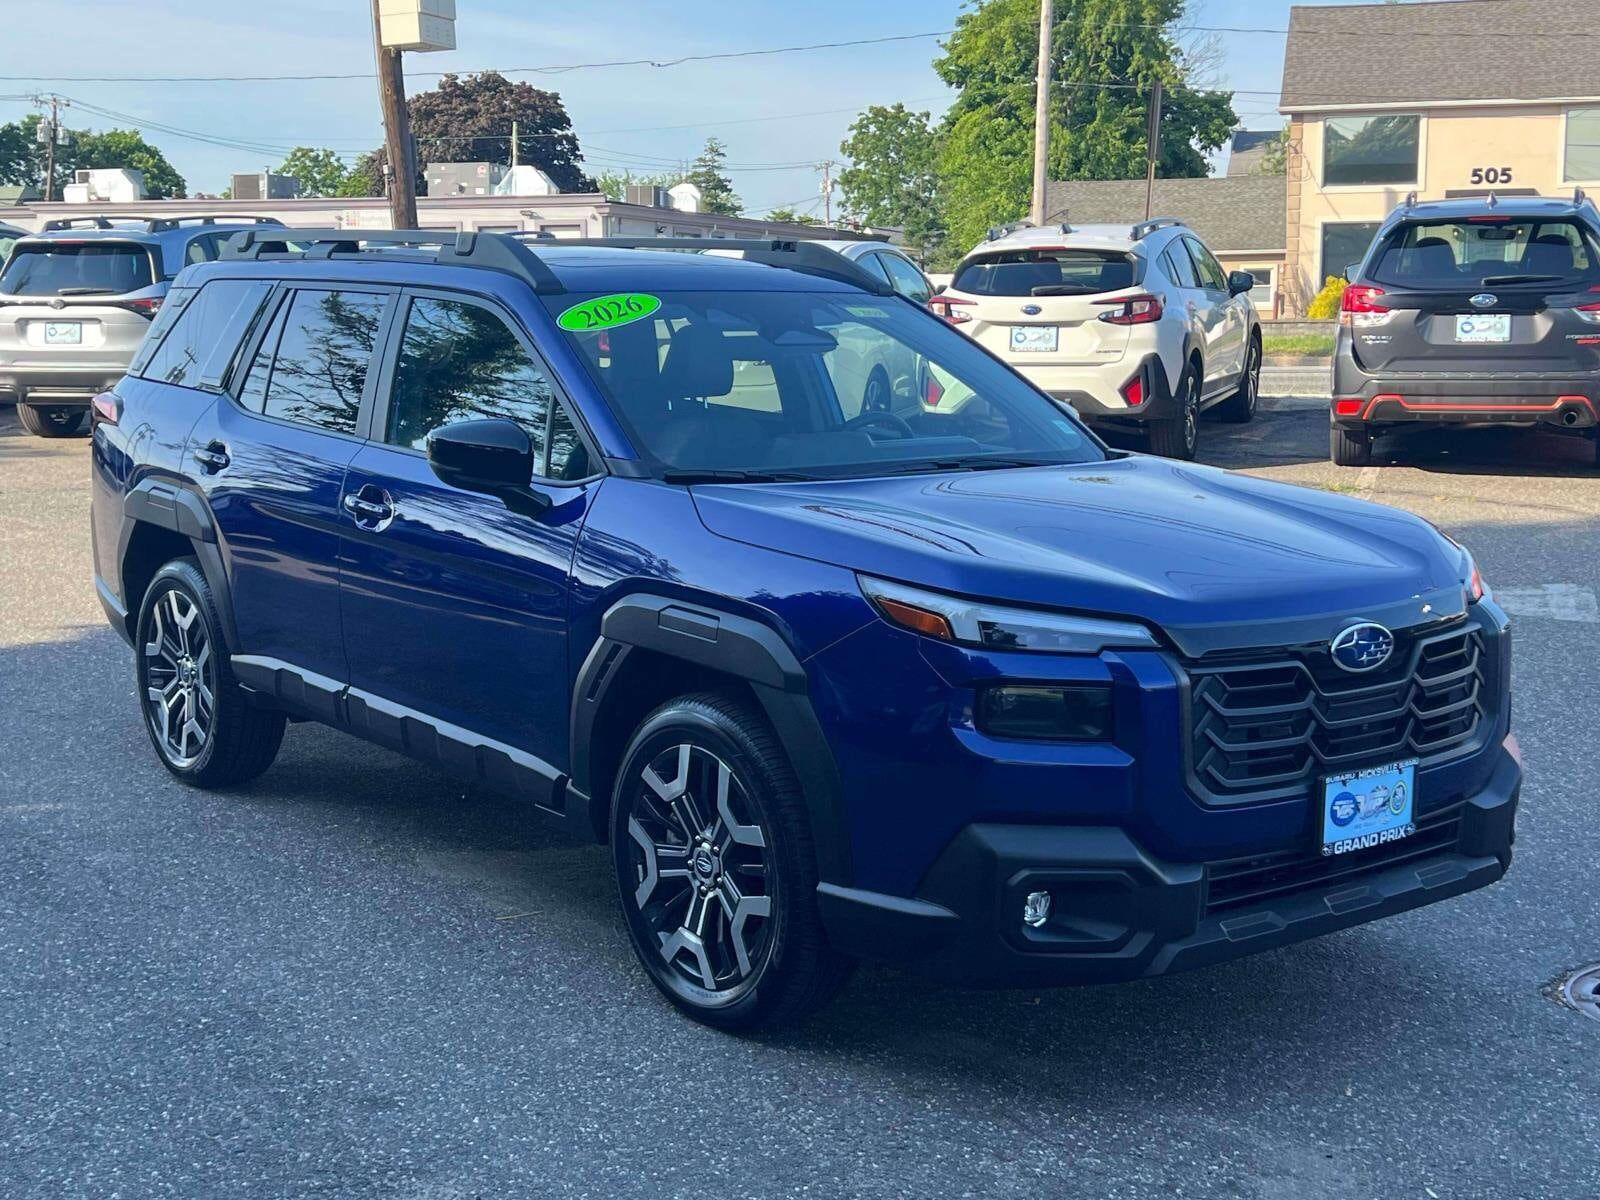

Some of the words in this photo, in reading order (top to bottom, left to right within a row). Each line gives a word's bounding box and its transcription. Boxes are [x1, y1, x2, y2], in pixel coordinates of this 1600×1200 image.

[1470, 167, 1512, 184] 505
[577, 296, 643, 328] 2026
[1325, 773, 1355, 784] SUBARU
[1358, 762, 1399, 778] HICKSVILLE
[1334, 833, 1379, 854] GRAND
[1380, 825, 1406, 844] PRIX
